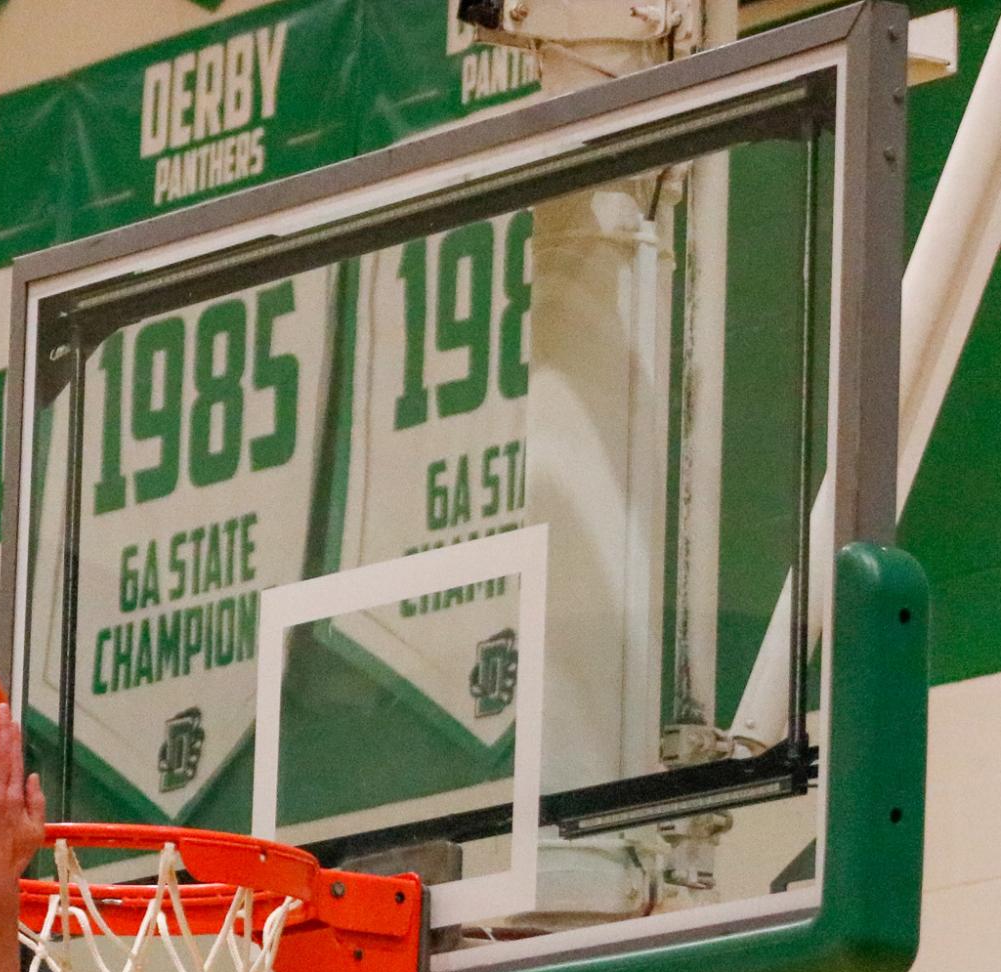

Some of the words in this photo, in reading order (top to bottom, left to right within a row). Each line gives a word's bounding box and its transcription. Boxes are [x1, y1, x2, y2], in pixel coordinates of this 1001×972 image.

[140, 22, 288, 158] DERBY
[154, 129, 264, 205] PANTHERS
[394, 208, 533, 431] 198
[94, 280, 299, 516] 1985
[426, 453, 471, 531] 6A
[120, 539, 160, 613] 6A
[168, 512, 258, 601] STATE
[92, 590, 260, 695] CHAMPION
